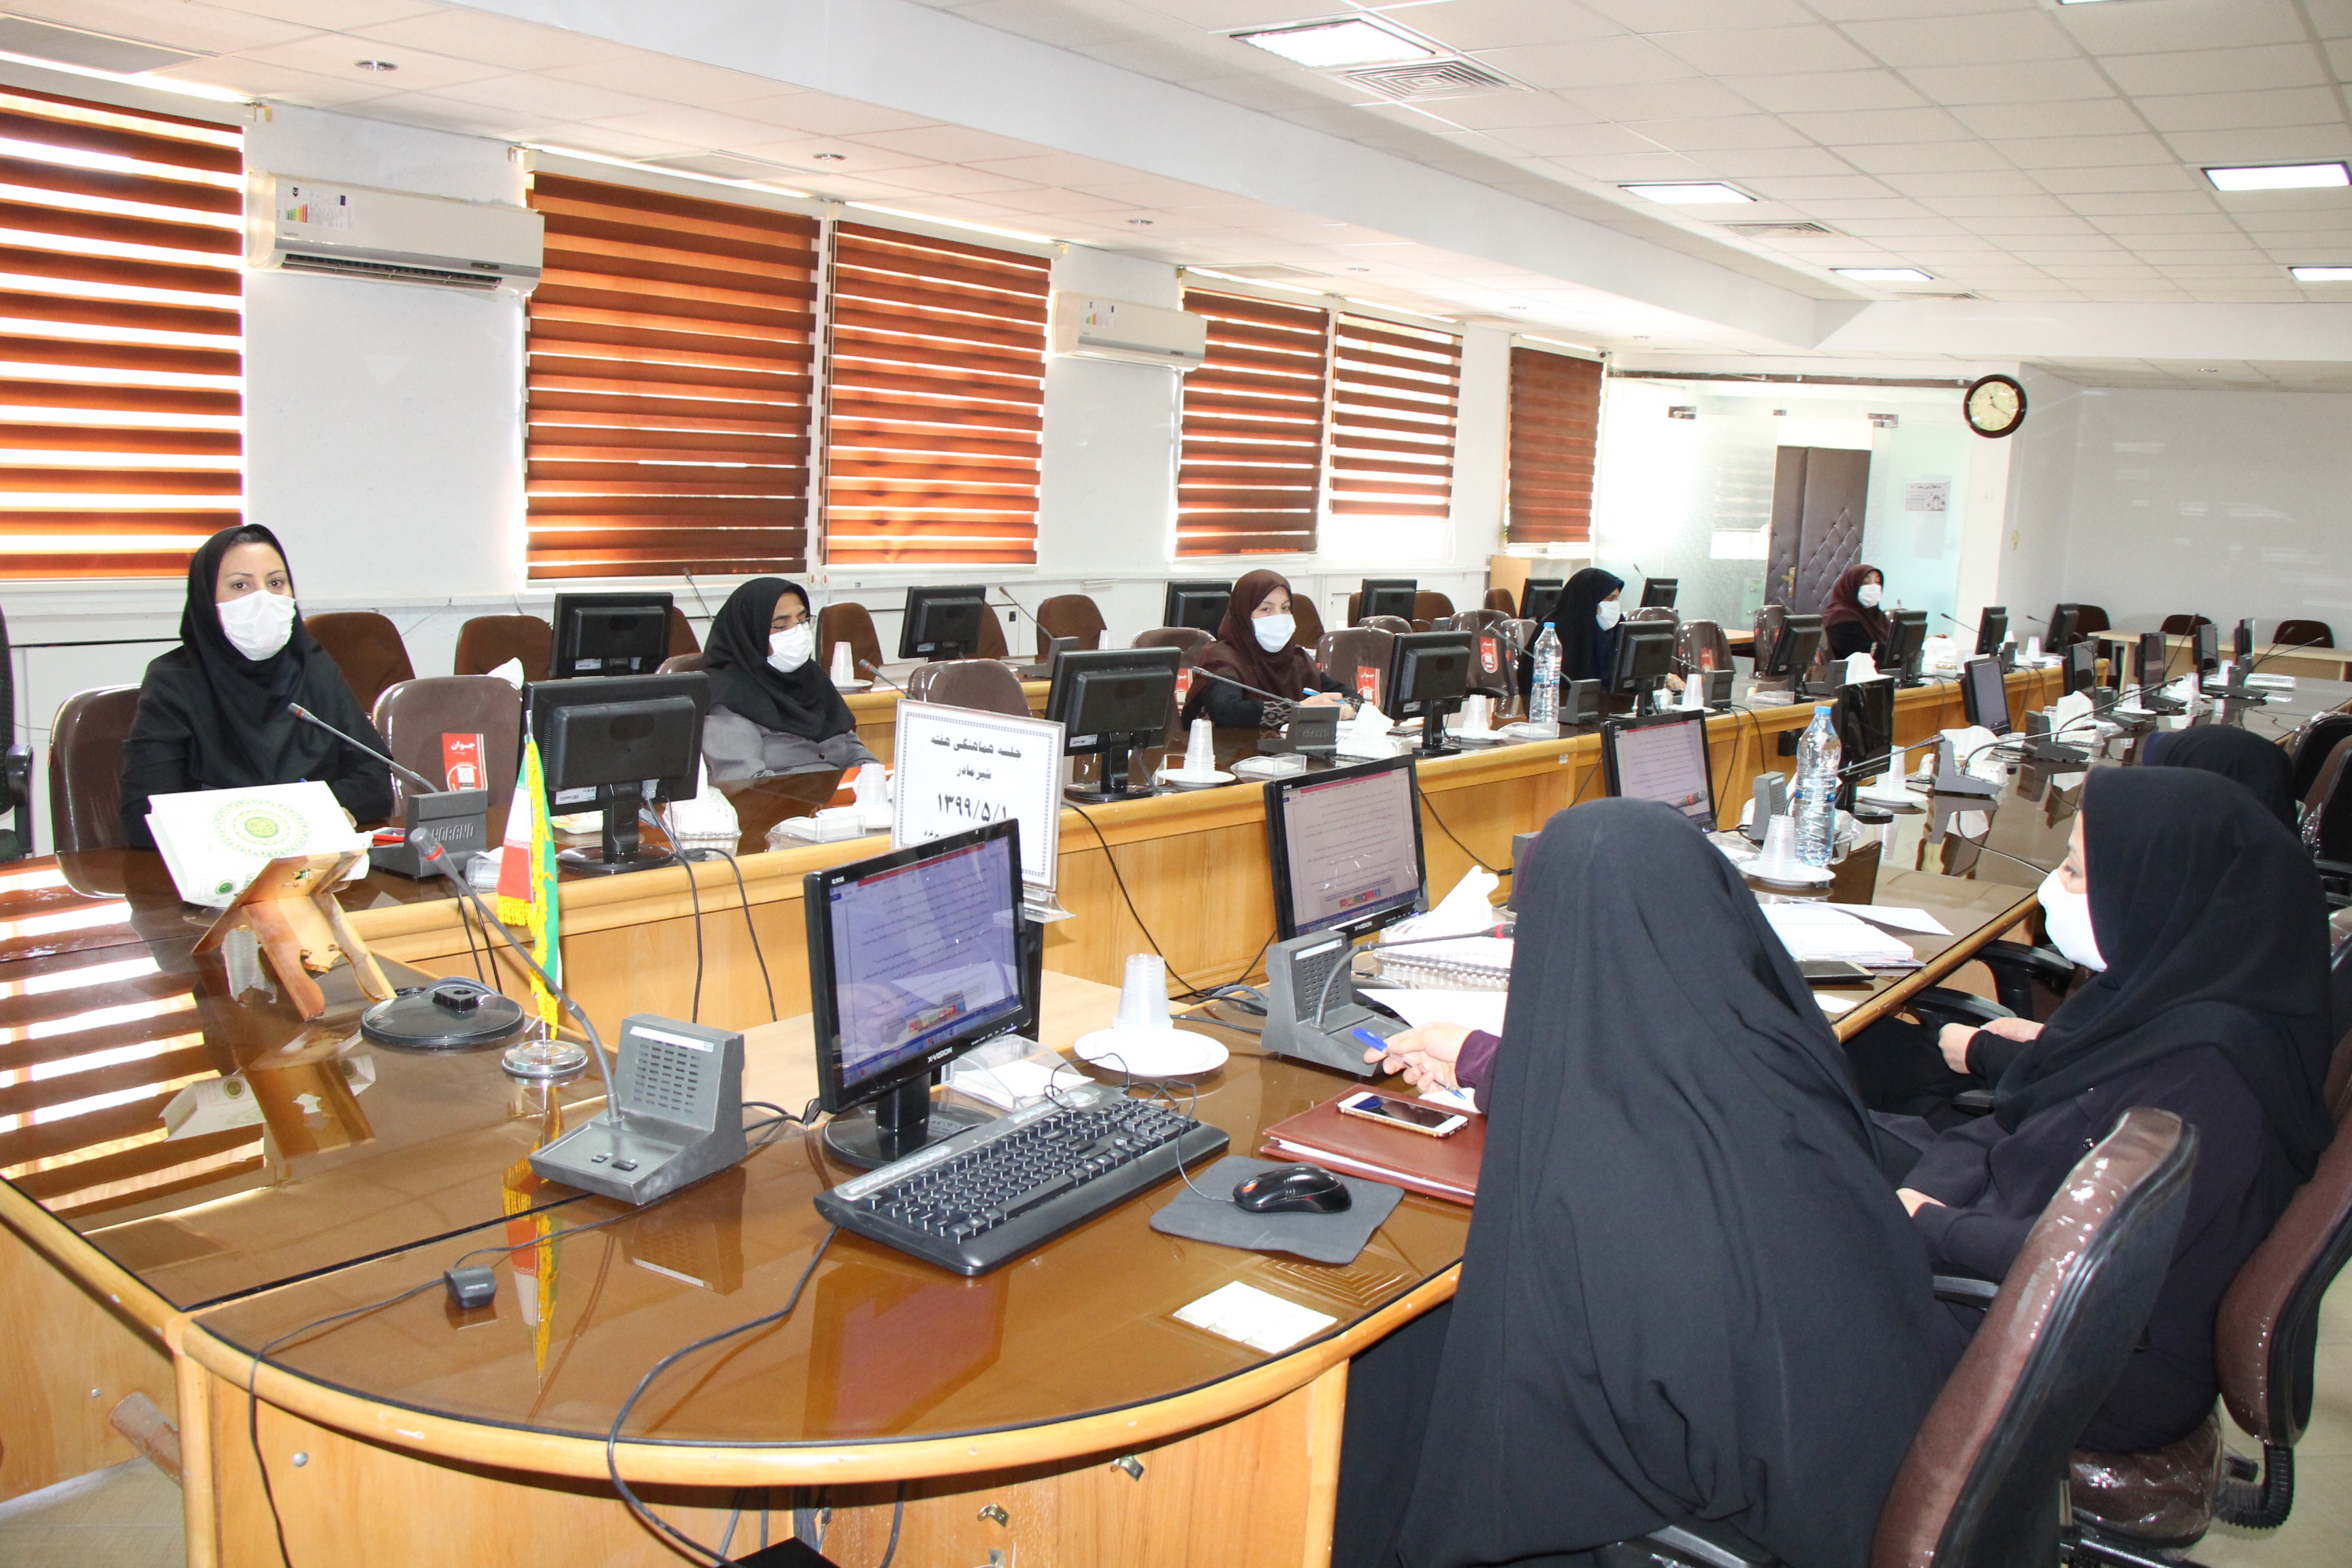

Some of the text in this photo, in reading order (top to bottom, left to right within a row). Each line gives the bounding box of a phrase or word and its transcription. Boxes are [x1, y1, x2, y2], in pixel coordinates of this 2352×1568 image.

[451, 740, 476, 751] جوان
[931, 734, 1022, 762] جلسه هماهنگی هفته
[956, 764, 991, 781] شیر مادر
